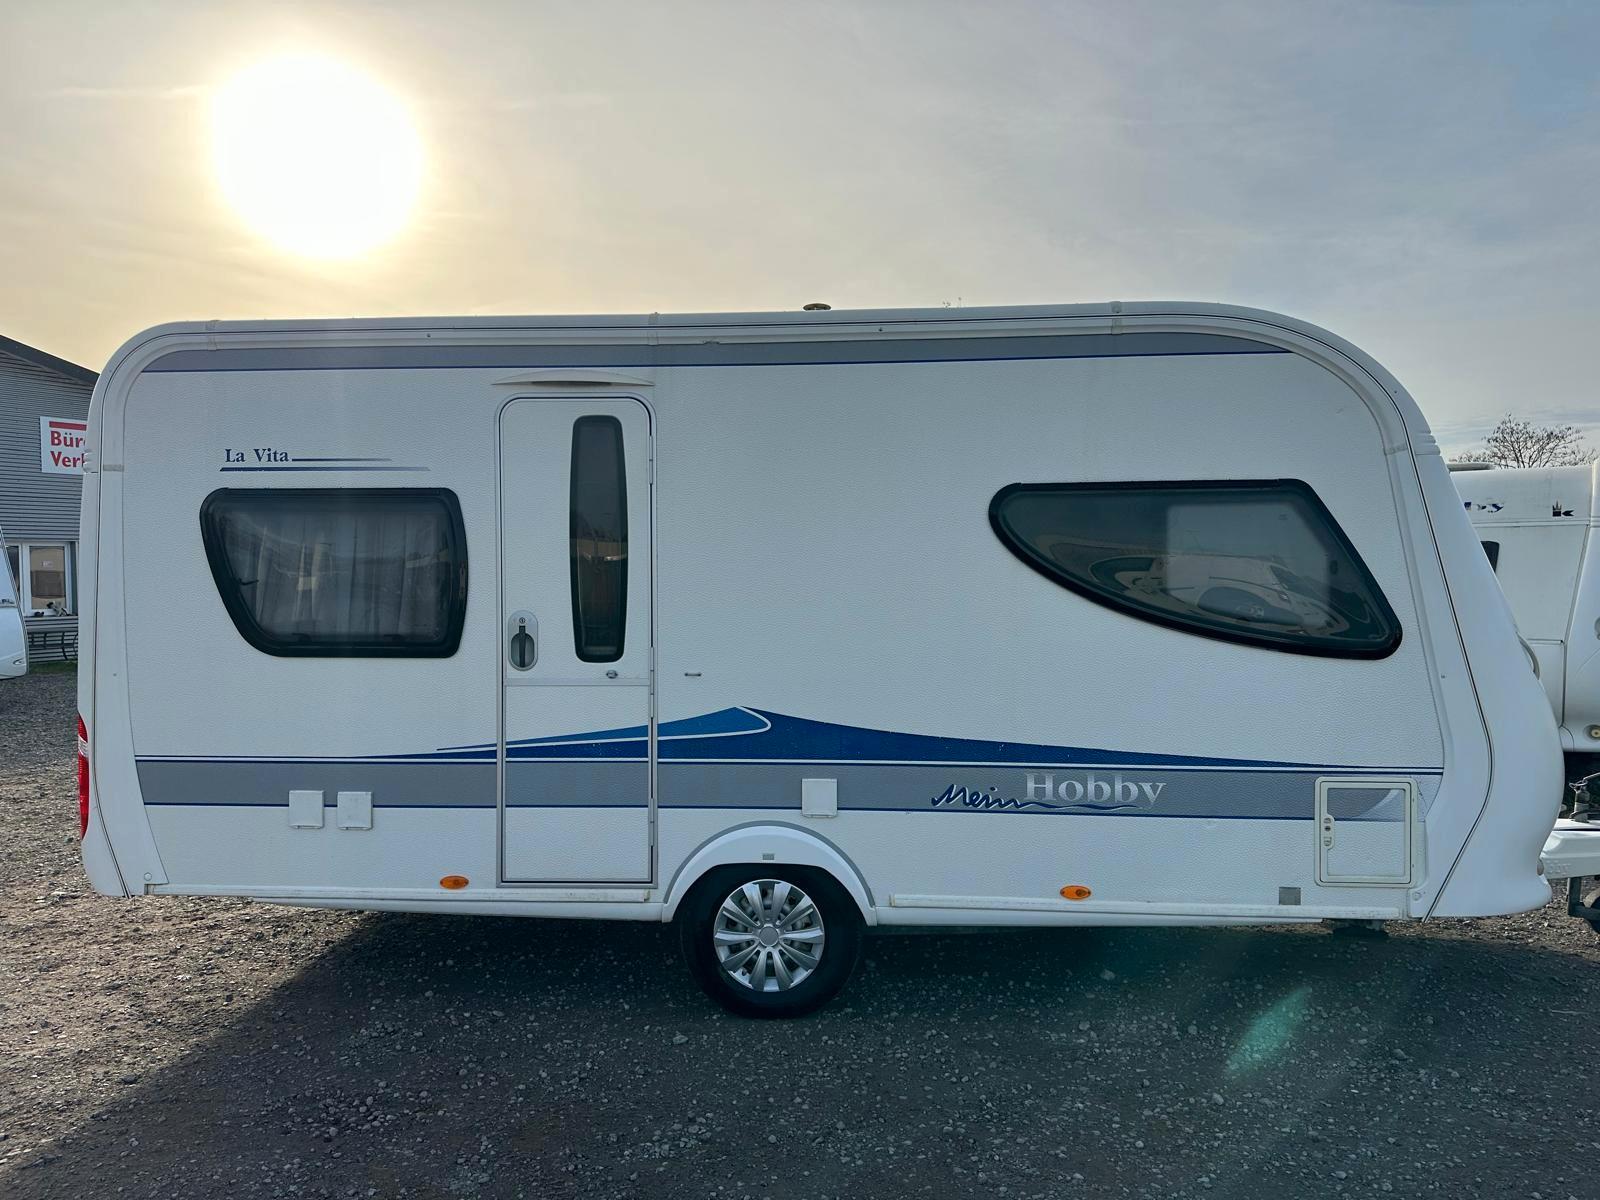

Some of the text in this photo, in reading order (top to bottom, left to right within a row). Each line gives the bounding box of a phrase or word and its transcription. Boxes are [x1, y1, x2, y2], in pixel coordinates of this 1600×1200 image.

[50, 430, 86, 448] Bür
[225, 447, 289, 463] La Vita
[931, 772, 1167, 809] Mein Hobby
